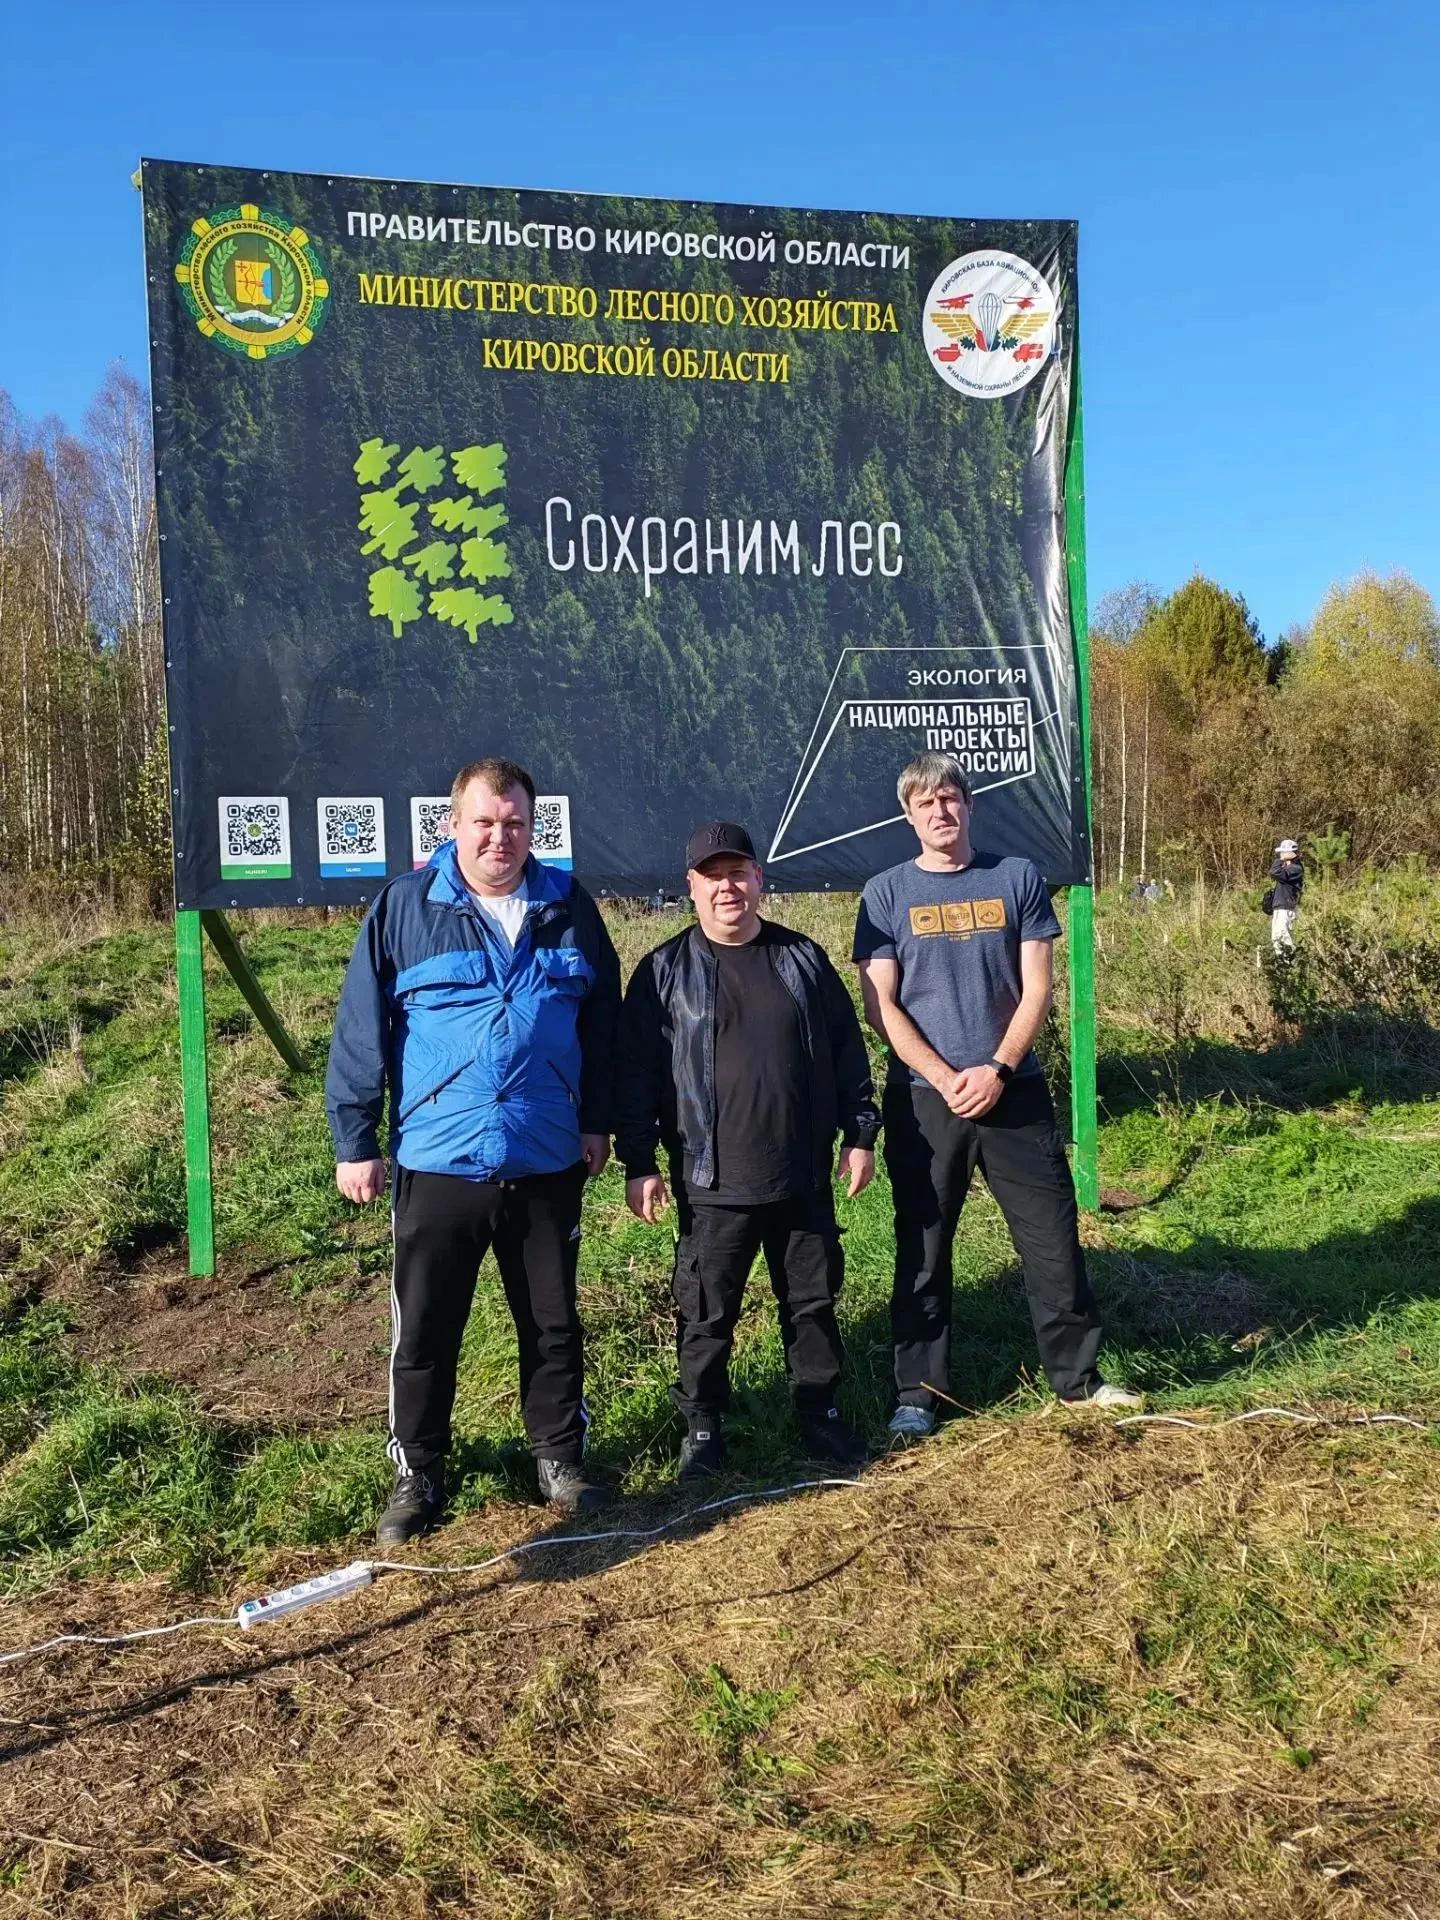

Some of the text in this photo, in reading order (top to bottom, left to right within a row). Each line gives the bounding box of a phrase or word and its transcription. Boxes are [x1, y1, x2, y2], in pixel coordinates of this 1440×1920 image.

[347, 211, 910, 270] ПРАВИТЕЛЬСТВО КИРОВСКОЙ ОБЛАСТИ
[193, 222, 312, 325] Министерство лесного хозяйства Кировской области
[941, 263, 976, 294] КИРОВСКАЯ
[976, 260, 995, 268] БАЗА
[357, 272, 899, 333] МИНИСТЕРСТВО ЛЕСНОГО ХОЗЯЙСТВА
[481, 336, 790, 383] КИРОВСКОЙ ОБЛАСТИ
[546, 496, 902, 598] Сохраним лес
[908, 668, 1027, 686] ЭКОЛОГИЯ
[849, 703, 1026, 729] НАЦИОНАЛЬНЫЕ
[926, 727, 1027, 750] ПРОЕКТЫ
[946, 750, 1028, 773] ОССИИ
